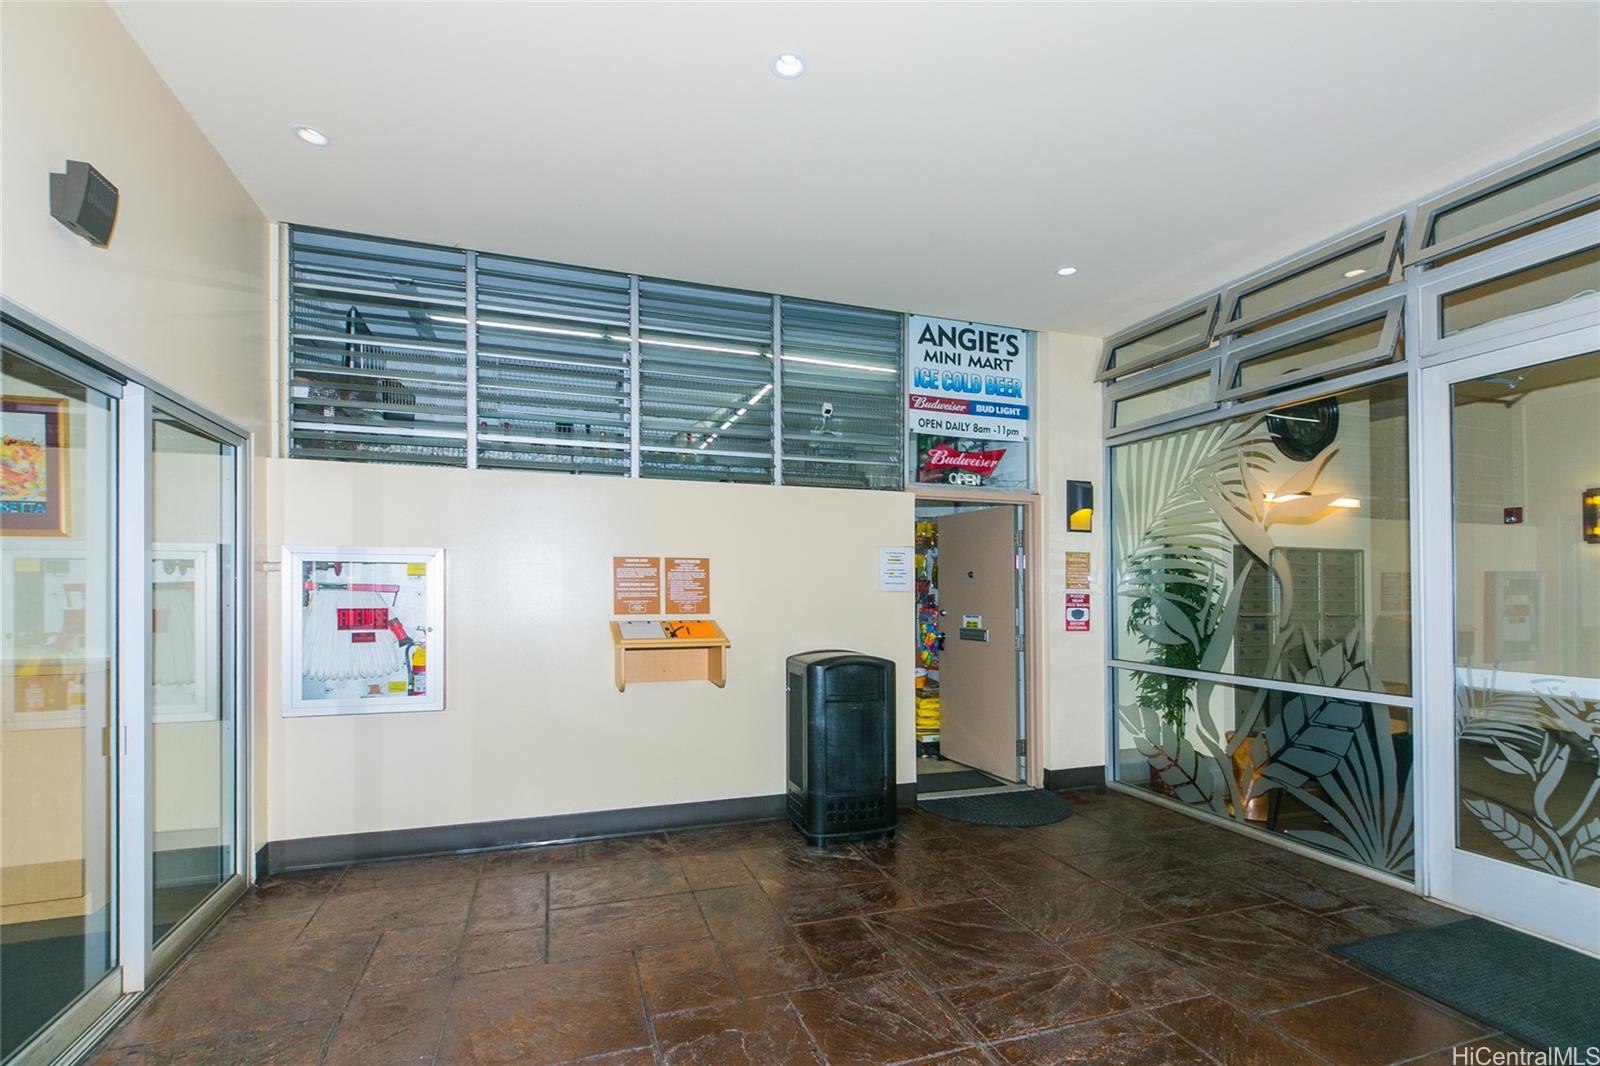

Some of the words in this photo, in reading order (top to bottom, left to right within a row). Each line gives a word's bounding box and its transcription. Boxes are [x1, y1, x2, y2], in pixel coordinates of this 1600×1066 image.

[917, 322, 1020, 357] ANGIE'S
[923, 349, 962, 366] MINI
[968, 355, 1014, 372] MART
[914, 367, 939, 390] ICE
[941, 371, 982, 394] COLD
[984, 374, 1023, 399] BEER
[911, 395, 967, 413] Budweiser
[975, 404, 995, 414] BUD
[995, 405, 1021, 416] LIGHT
[918, 417, 943, 429] OPEN
[945, 420, 971, 432] DAILY
[972, 423, 991, 434] 8am
[927, 448, 998, 468] Budweiser
[948, 472, 981, 486] OPEN
